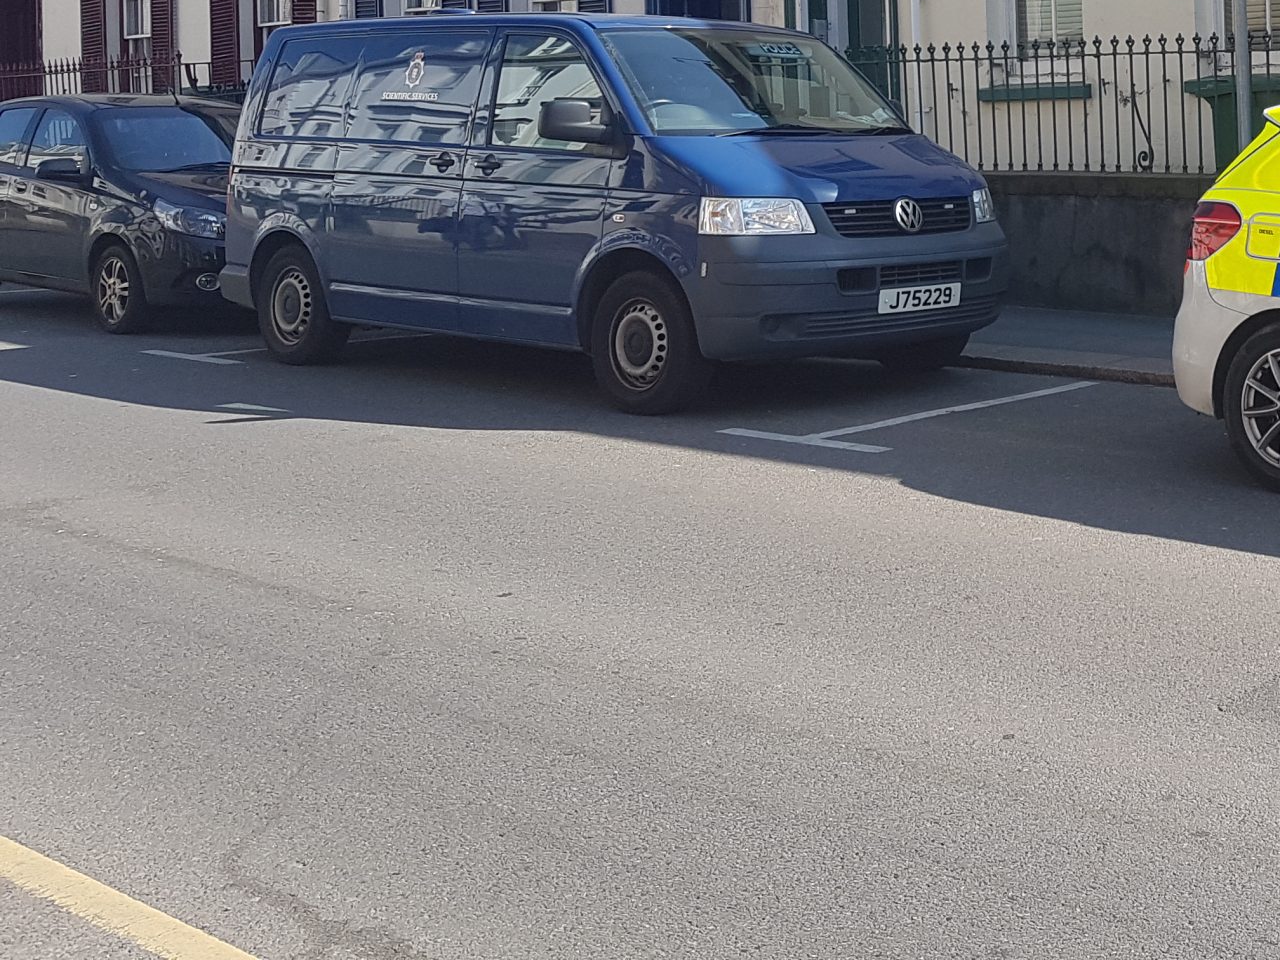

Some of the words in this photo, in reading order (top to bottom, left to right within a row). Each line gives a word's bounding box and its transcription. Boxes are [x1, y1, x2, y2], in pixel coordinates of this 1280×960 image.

[382, 91, 412, 100] SCIENTIFIC
[412, 92, 439, 101] SERVICES
[889, 286, 953, 310] J75229
